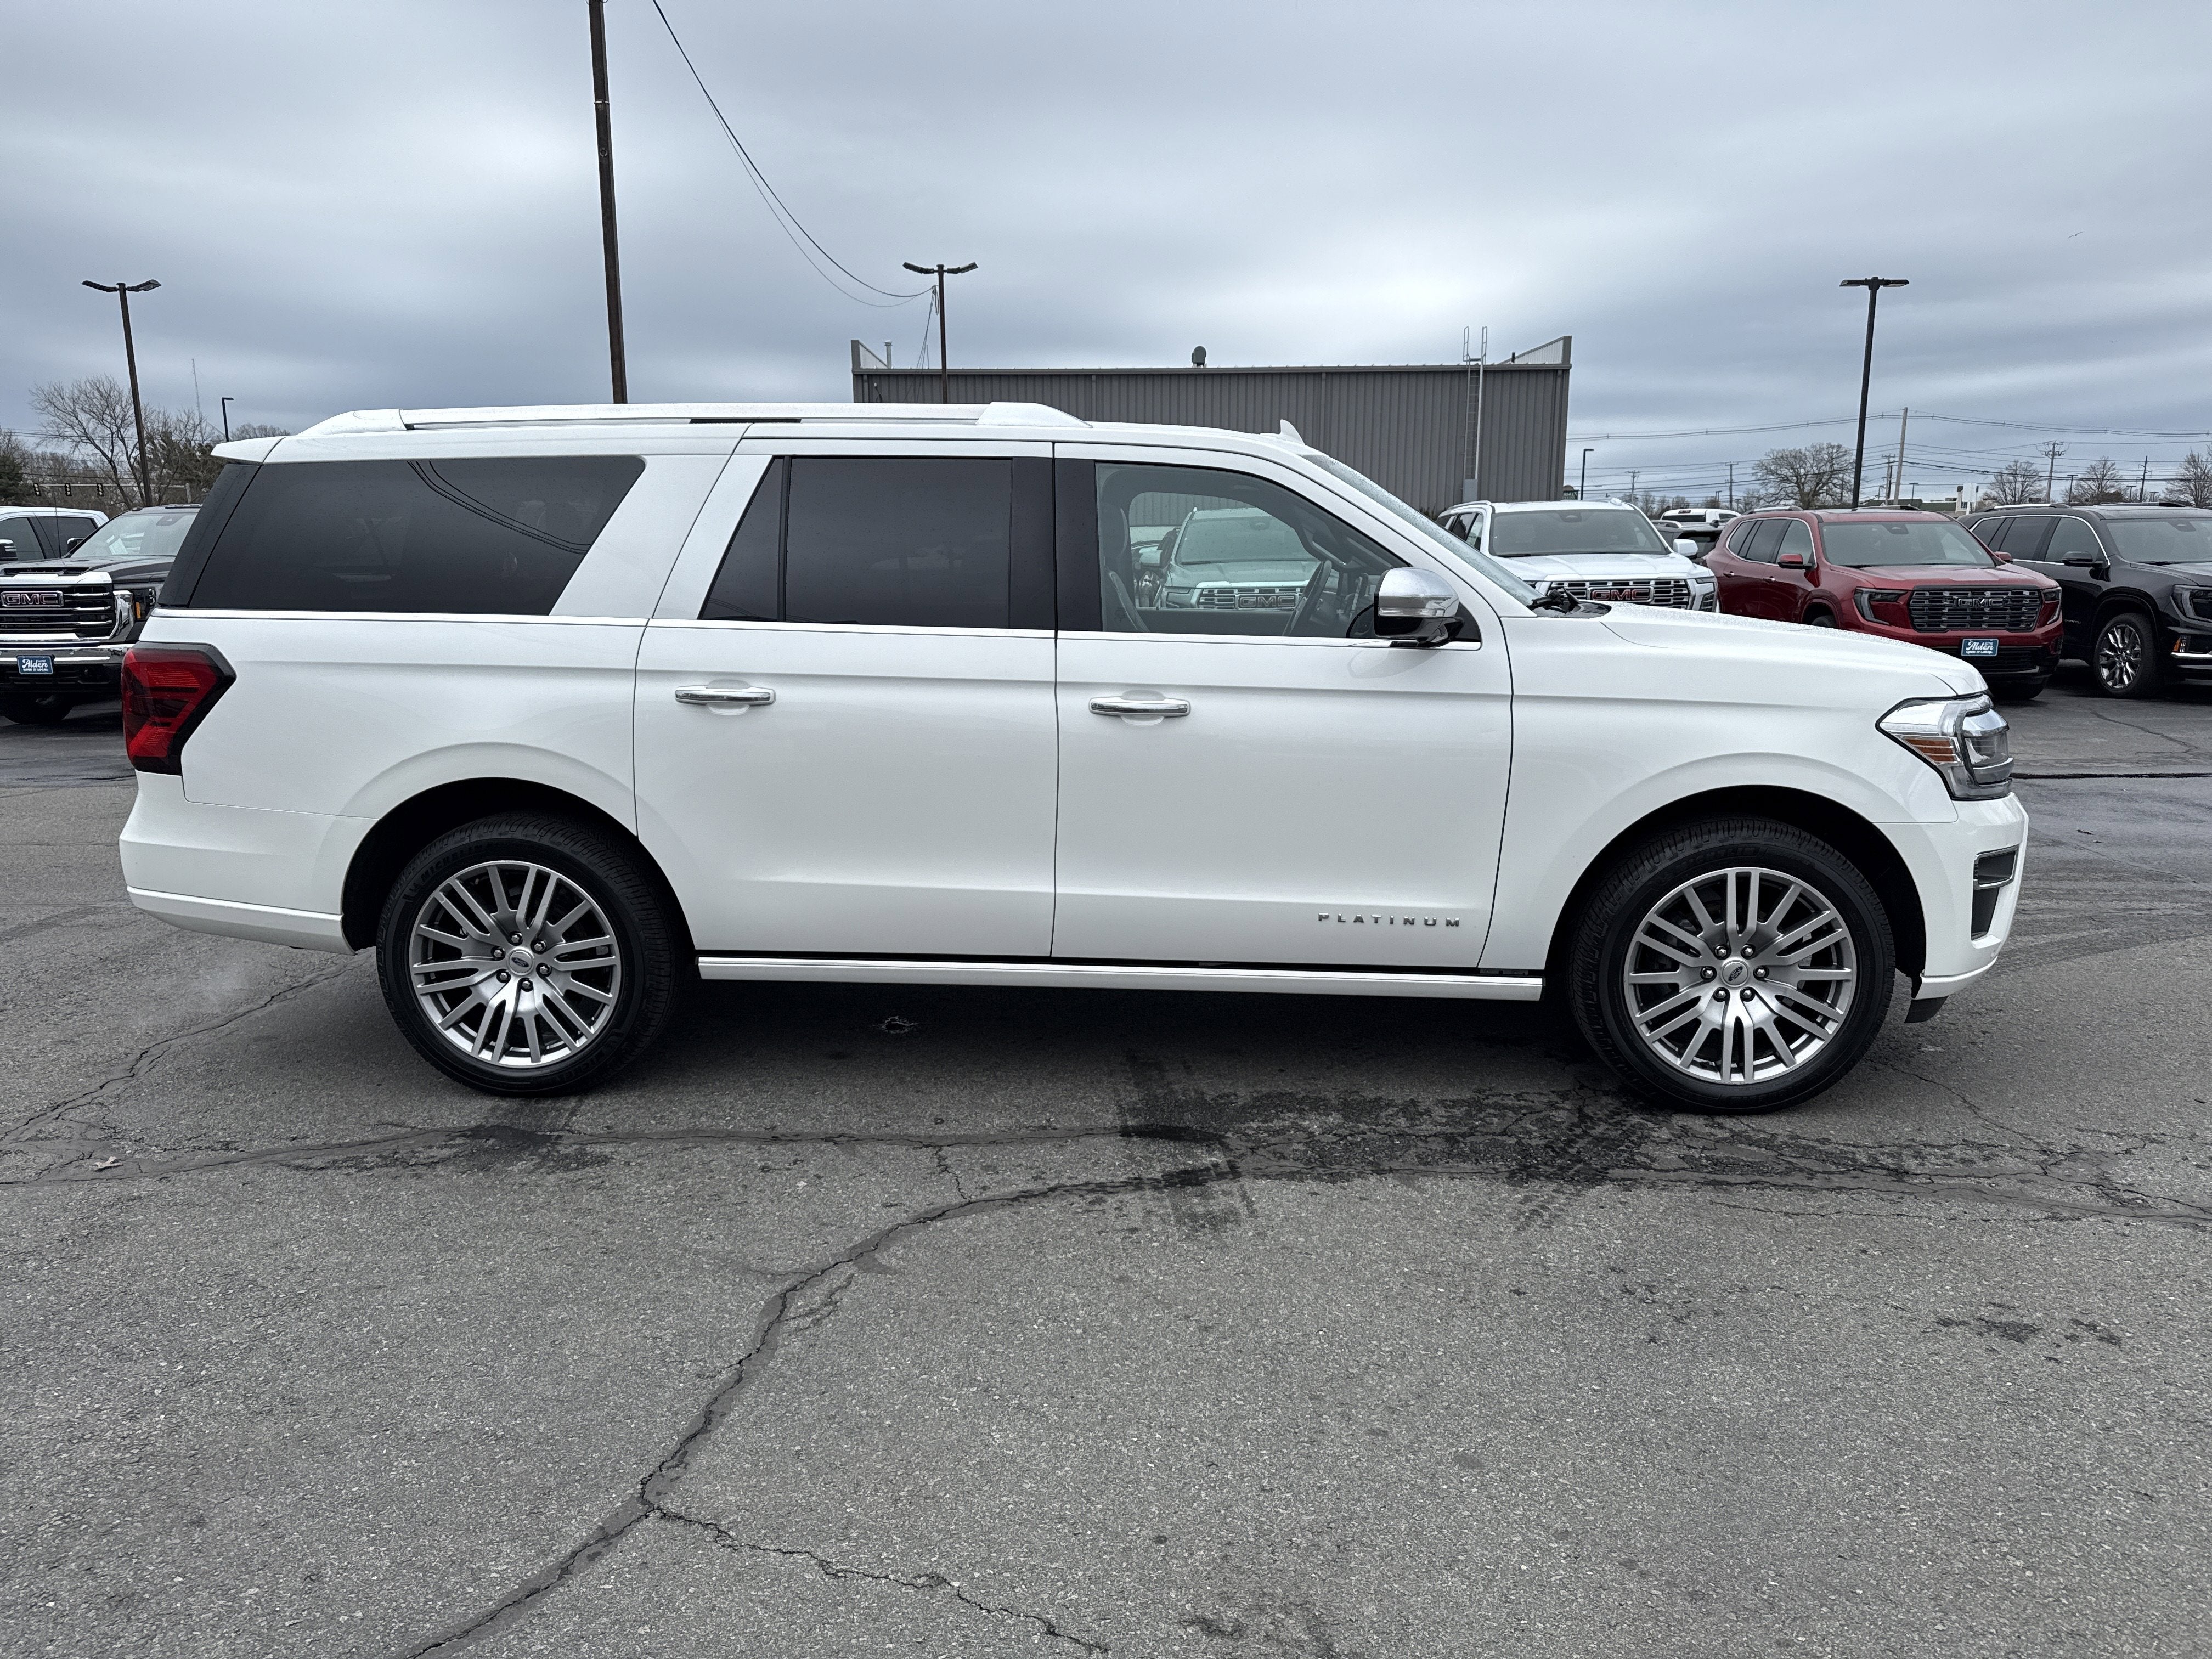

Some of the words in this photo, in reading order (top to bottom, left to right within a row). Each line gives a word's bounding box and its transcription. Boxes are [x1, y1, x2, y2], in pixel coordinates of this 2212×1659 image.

[4, 594, 58, 605] GMC
[1592, 589, 1649, 600] GMC
[1240, 596, 1295, 607] GMC
[1958, 598, 2004, 607] GMC
[1966, 641, 1994, 651] Alden
[22, 659, 49, 668] Alden
[1318, 912, 1460, 927] PLATINUM
